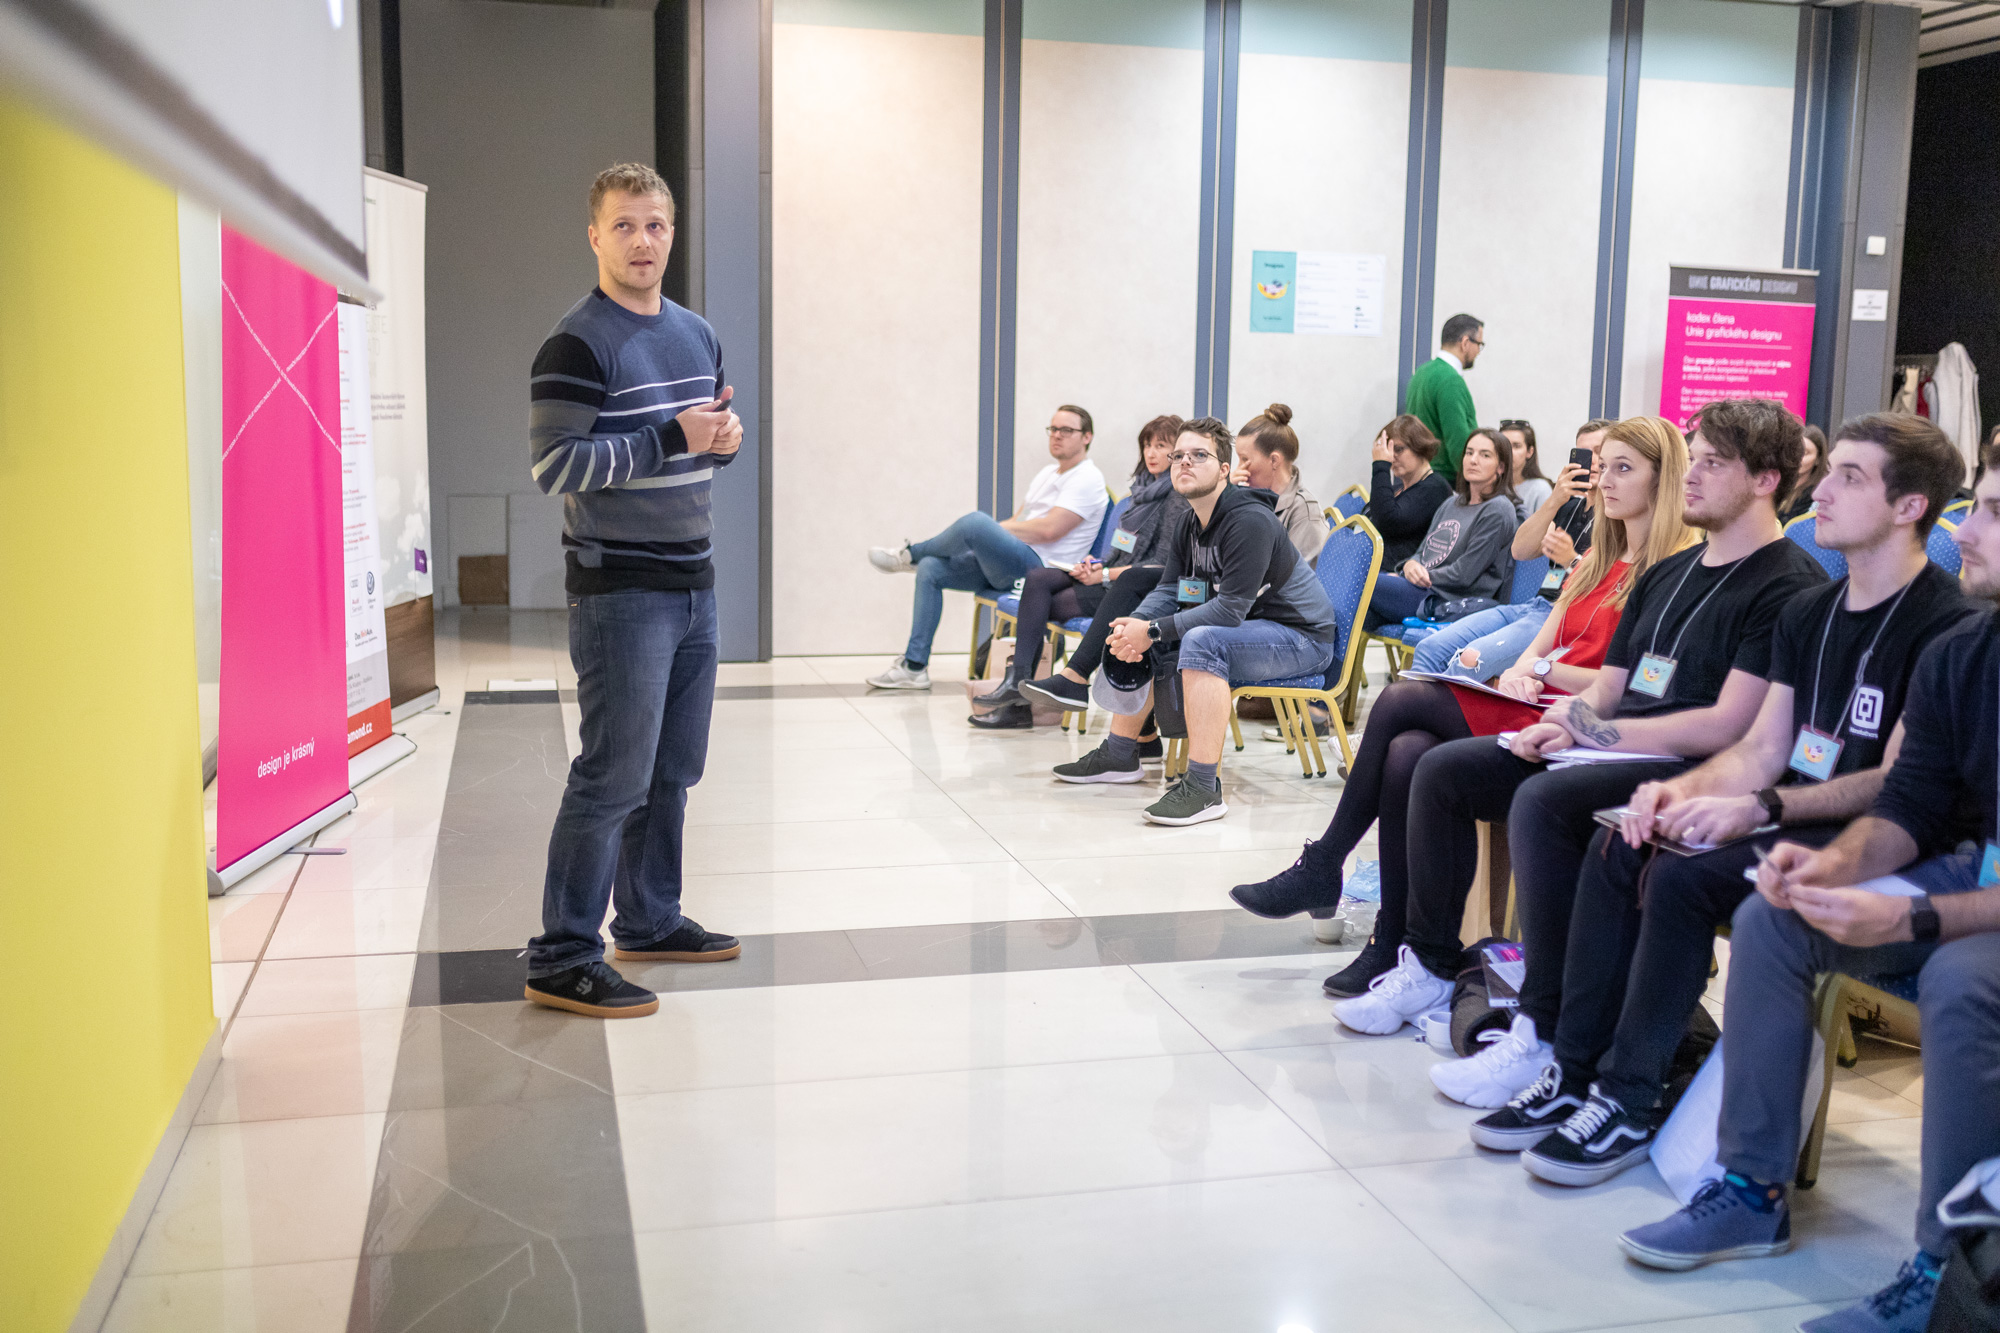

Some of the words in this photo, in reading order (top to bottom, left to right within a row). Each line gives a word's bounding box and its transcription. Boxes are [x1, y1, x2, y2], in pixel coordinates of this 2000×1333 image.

[1709, 275, 1761, 293] GRAFICKÉHO
[1686, 311, 1711, 324] kodex
[1712, 312, 1735, 325] člena
[1685, 325, 1704, 338] Unie
[1705, 327, 1749, 341] grafického
[1750, 328, 1782, 343] designu
[257, 756, 282, 778] design
[283, 750, 290, 770] je
[291, 737, 315, 762] krásný
